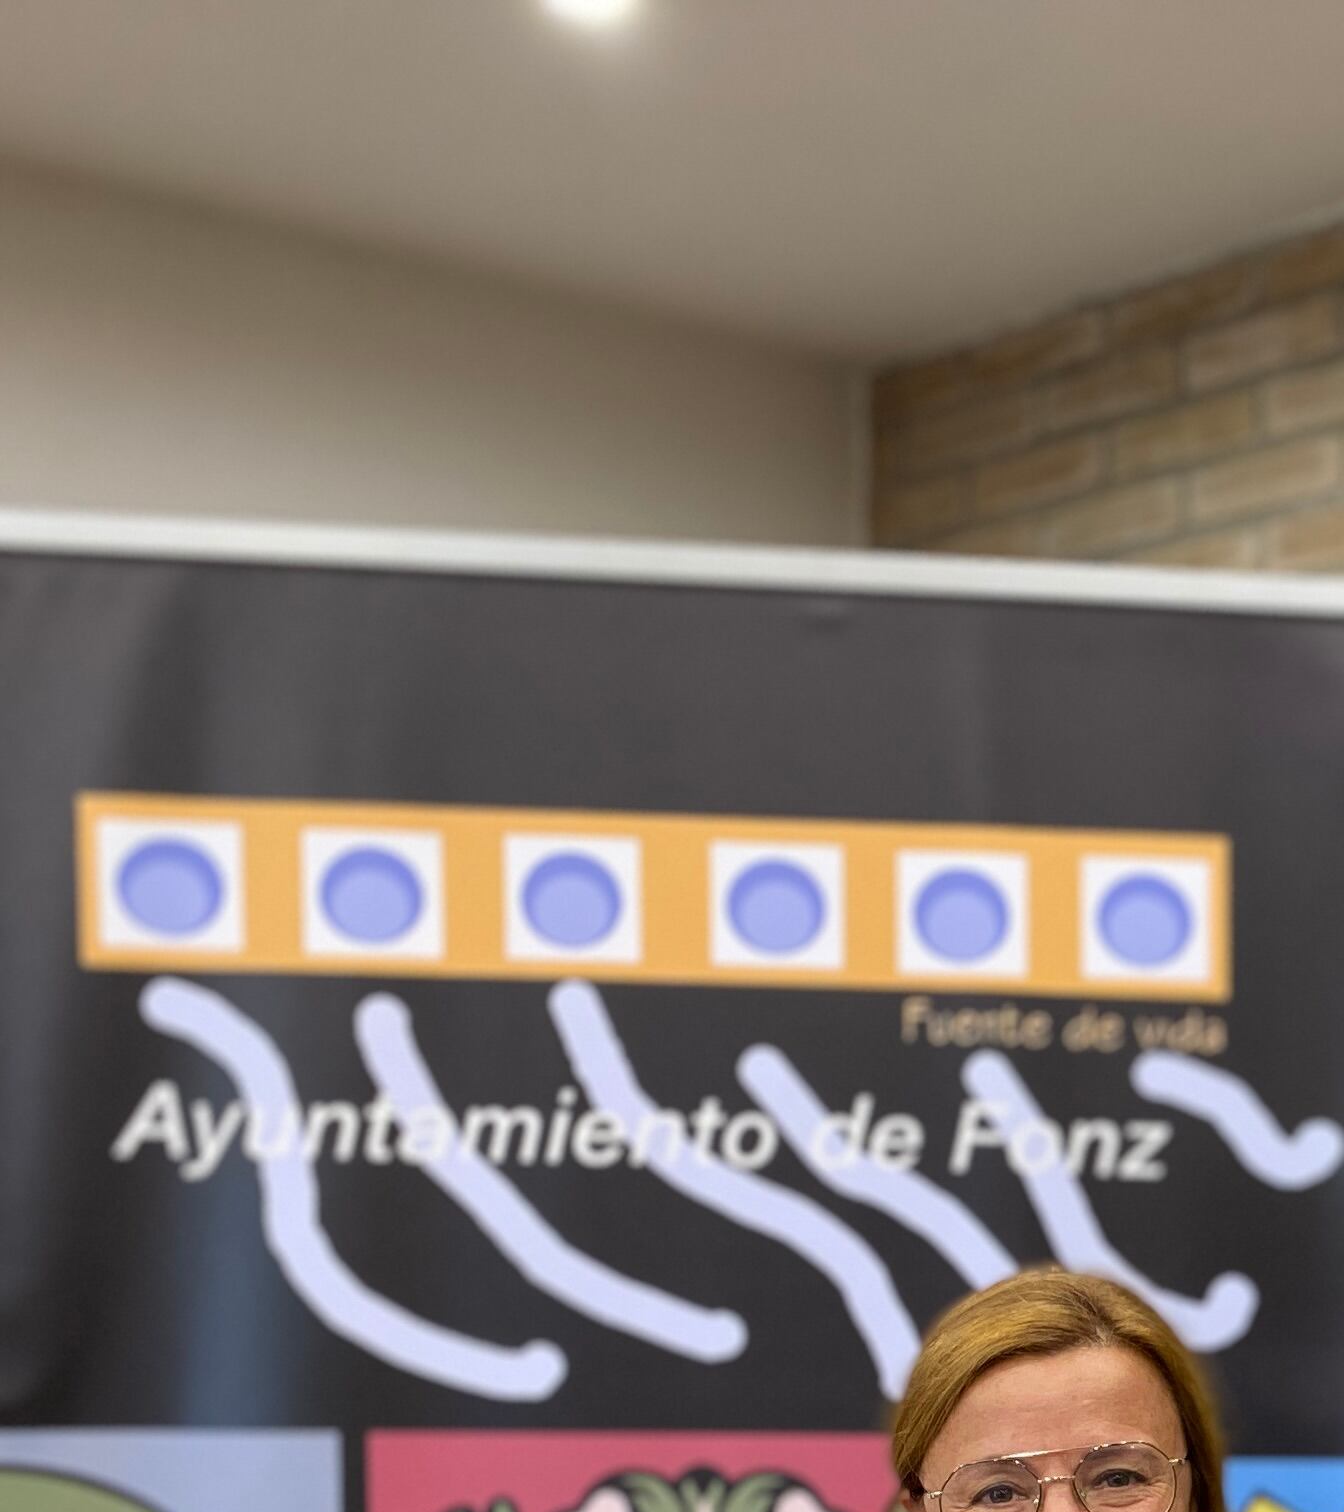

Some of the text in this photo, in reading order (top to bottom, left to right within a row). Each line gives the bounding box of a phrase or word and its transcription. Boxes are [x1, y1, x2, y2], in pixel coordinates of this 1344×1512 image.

[901, 996, 1054, 1051] Fuente
[1062, 1004, 1125, 1054] de
[109, 1078, 779, 1182] Ayuntamiento
[812, 1091, 925, 1173] de
